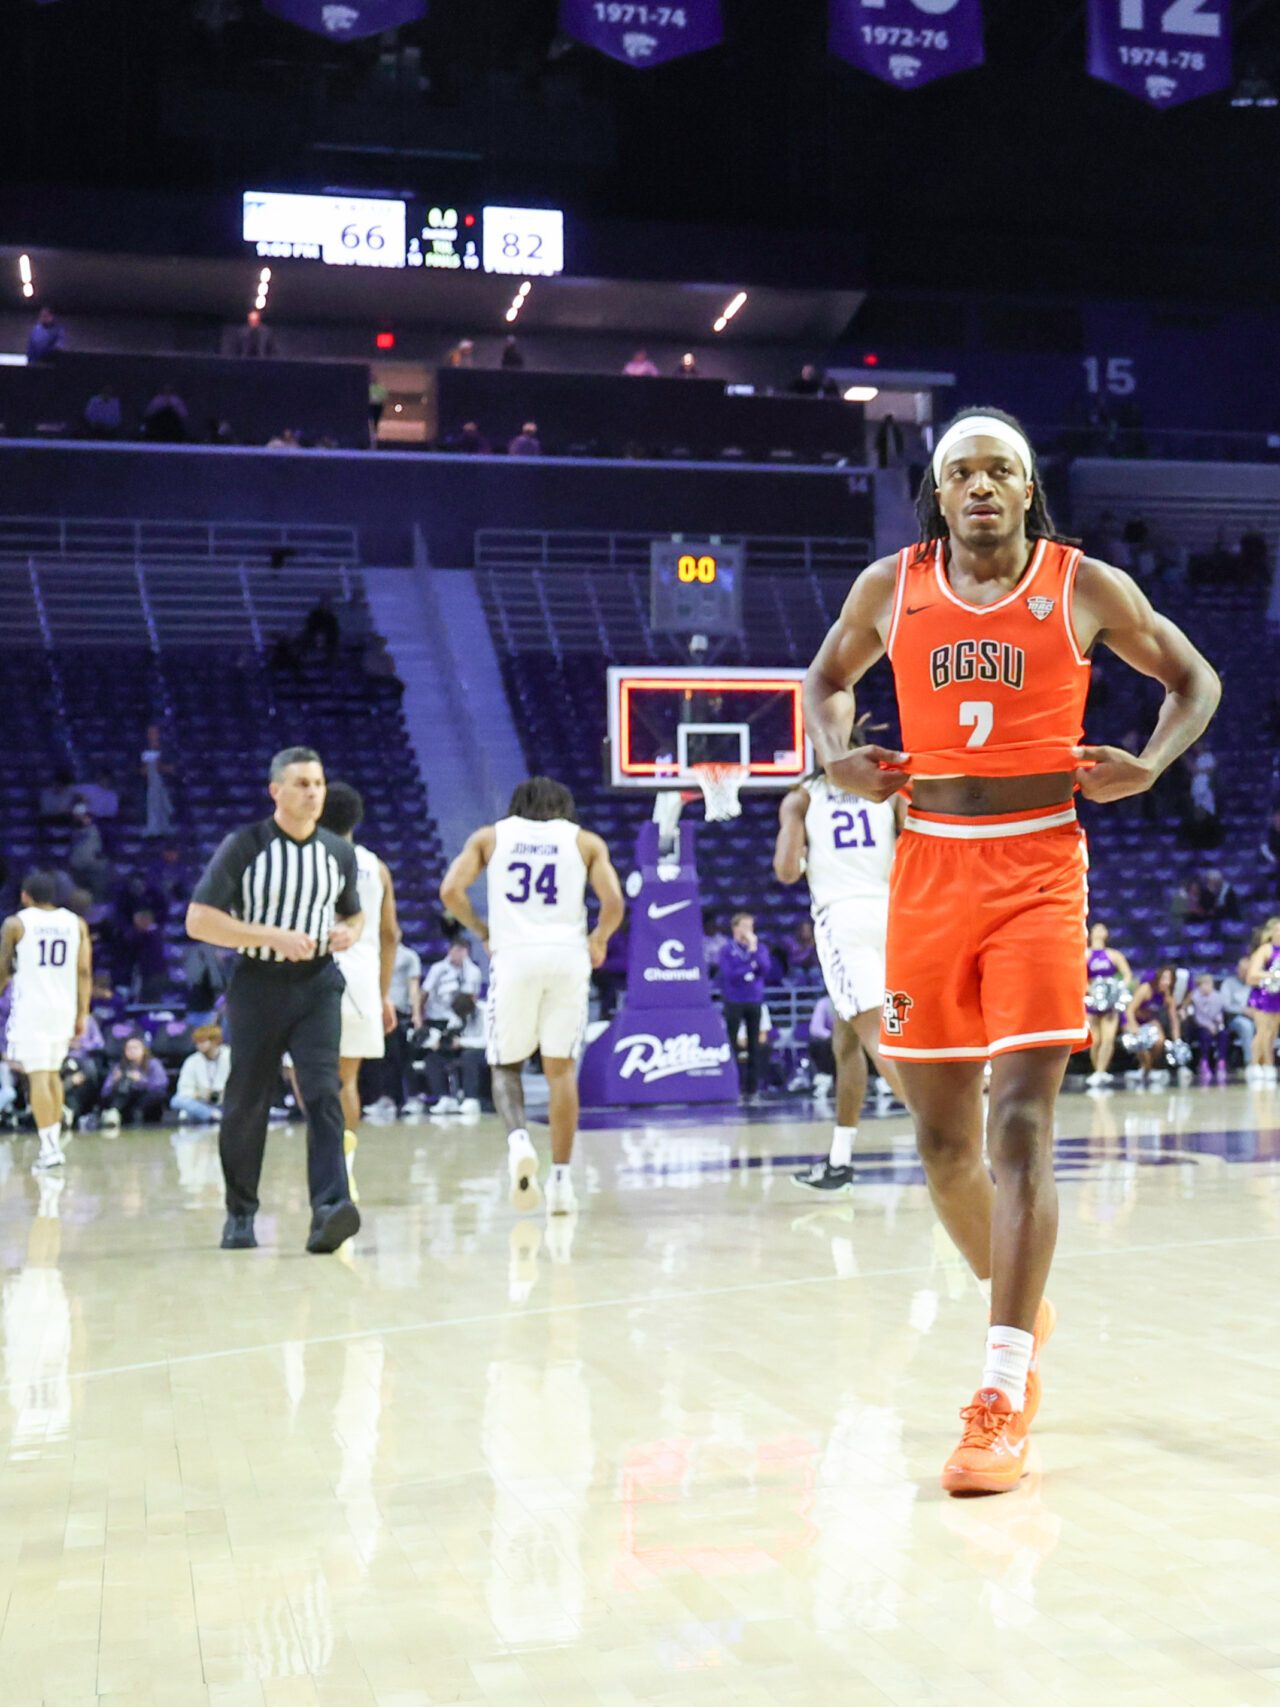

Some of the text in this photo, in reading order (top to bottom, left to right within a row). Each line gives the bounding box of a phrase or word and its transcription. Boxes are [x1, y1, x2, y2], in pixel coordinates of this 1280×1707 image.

[593, 2, 687, 28] 1971-74
[861, 25, 950, 51] 1972-76
[1118, 46, 1206, 71] 1974-78
[340, 223, 386, 250] 66
[501, 231, 544, 260] 82
[1082, 356, 1137, 396] 15
[929, 638, 1025, 692] BGSU
[831, 809, 877, 850] 21
[505, 862, 559, 905] 34
[38, 939, 67, 968] 10
[613, 1032, 732, 1084] Dillons
